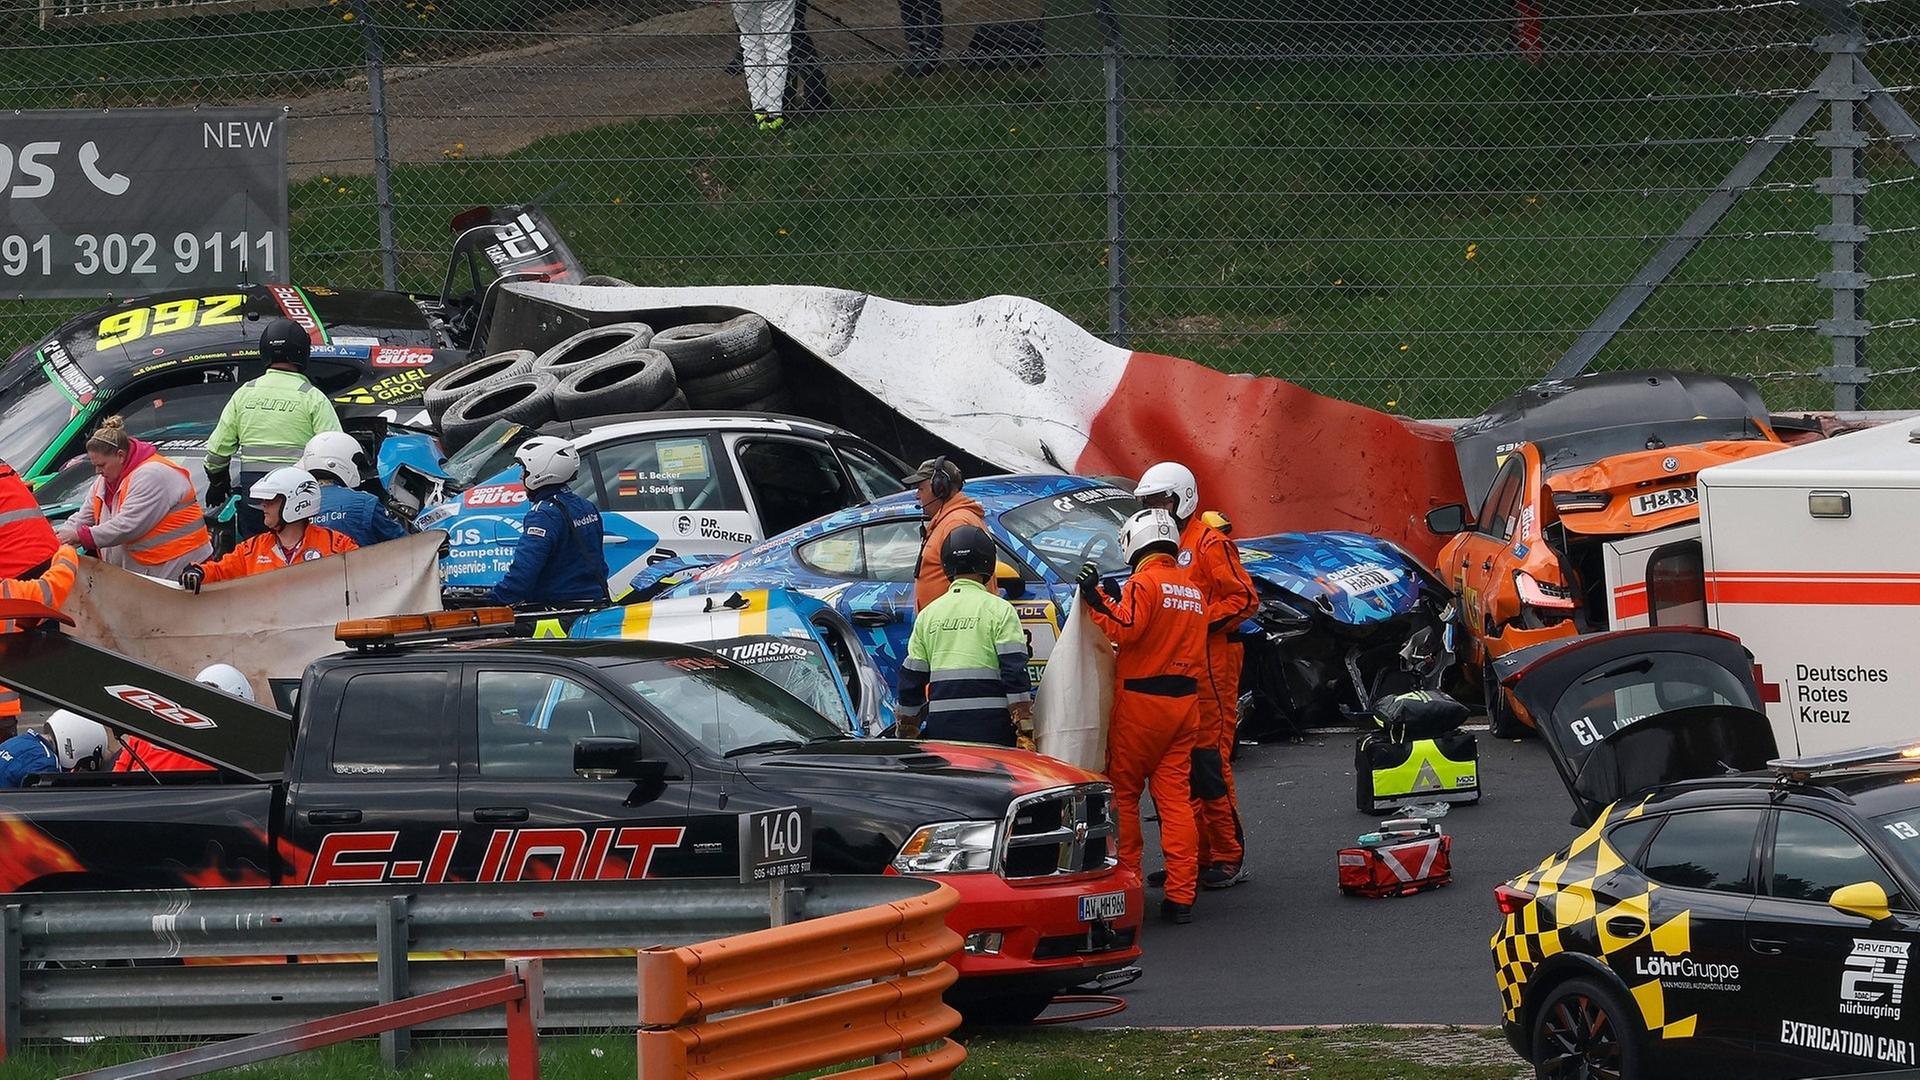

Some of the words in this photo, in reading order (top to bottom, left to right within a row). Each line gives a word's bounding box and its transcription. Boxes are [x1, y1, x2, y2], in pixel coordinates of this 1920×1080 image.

[204, 121, 274, 148] NEW
[2, 234, 51, 276] 91
[74, 233, 157, 275] 302
[173, 231, 274, 272] 9111
[96, 294, 247, 351] 992
[376, 353, 434, 364] auto
[639, 472, 648, 480] E.
[650, 471, 681, 480] Becker
[468, 491, 527, 505] auto
[474, 486, 505, 494] sport
[649, 485, 685, 495] Spölgen
[331, 511, 347, 520] Car
[701, 517, 720, 529] DR.
[448, 528, 480, 546] JS
[701, 528, 753, 544] WORKER
[449, 547, 514, 558] Competiti
[1161, 583, 1201, 600] DMSB
[1163, 597, 1204, 615] STAFFEL
[732, 642, 808, 660] TURISMO
[757, 655, 806, 665] SIMULATOR
[1796, 664, 1888, 682] Deutsches
[1798, 685, 1848, 702] Rotes
[1800, 706, 1851, 723] Kreuz
[760, 811, 802, 858] 140
[1883, 821, 1919, 840] 13
[308, 826, 687, 886] E-UNIT
[754, 867, 765, 879] SOS
[789, 863, 800, 874] 302
[1857, 943, 1905, 954] RAVENOL
[1635, 956, 1739, 982] LöhrGruppe
[1693, 983, 1724, 991] AUTOMOTIVE
[1840, 1001, 1901, 1020] nürburgring
[1781, 1019, 1874, 1058] EXTRICATION
[1877, 1037, 1907, 1064] CAR
[1909, 1042, 1916, 1065] 1
